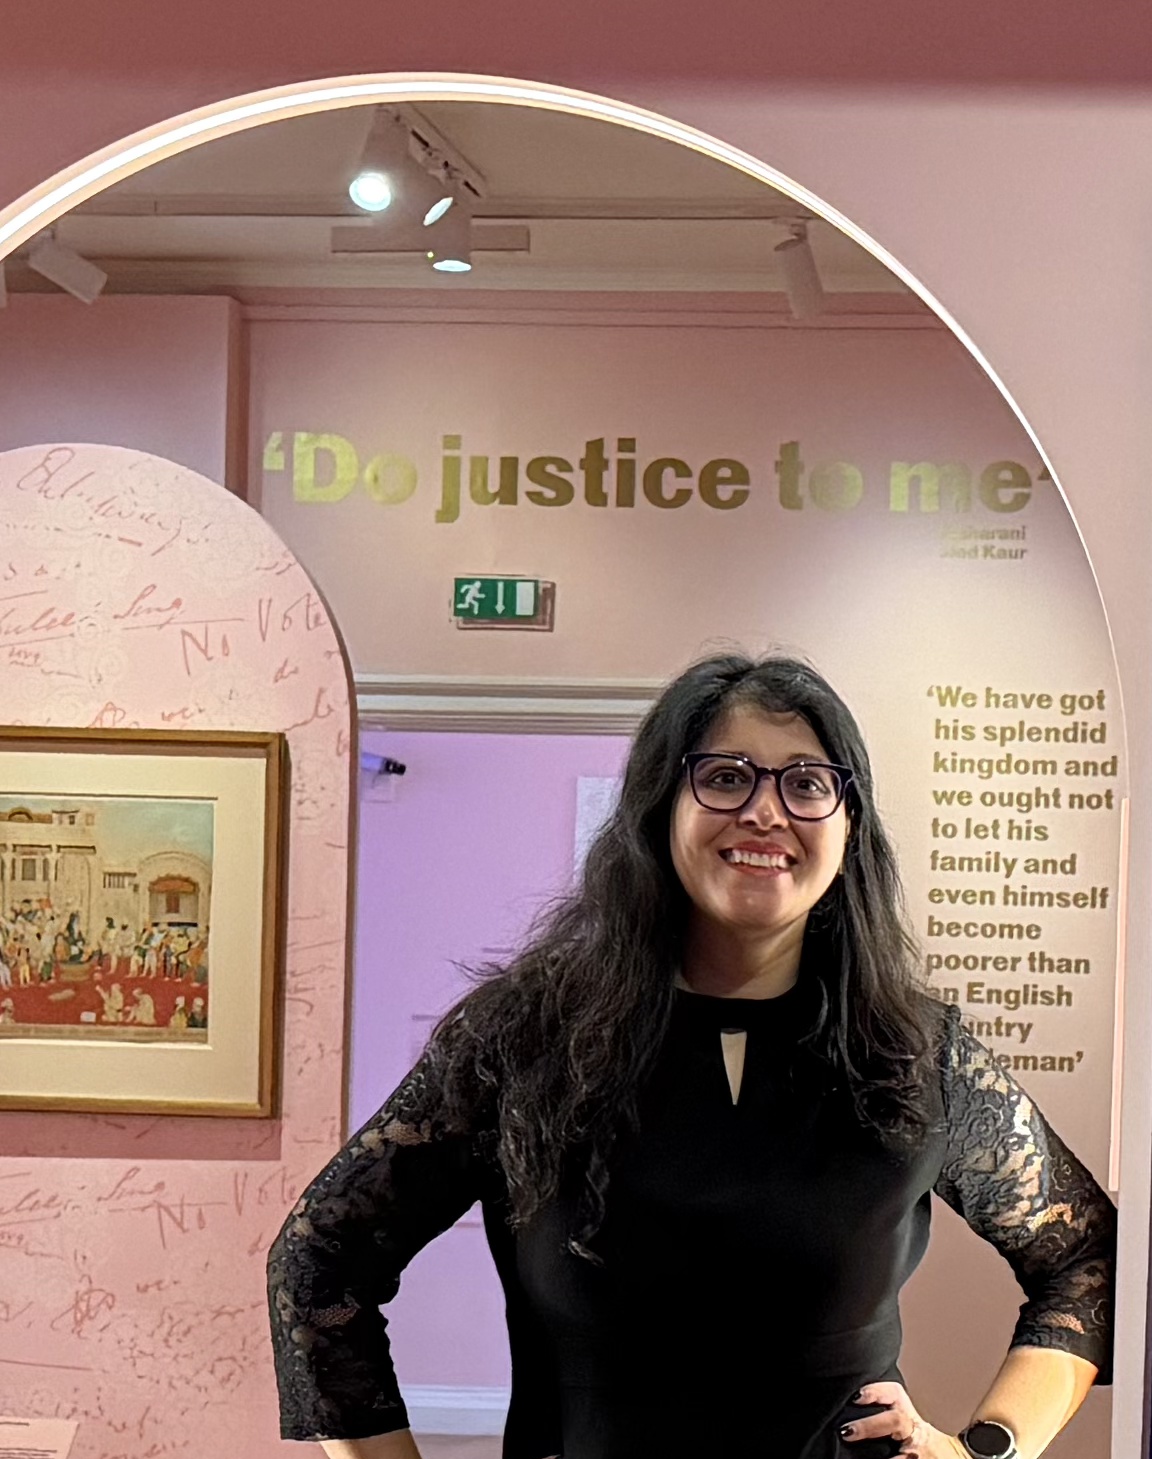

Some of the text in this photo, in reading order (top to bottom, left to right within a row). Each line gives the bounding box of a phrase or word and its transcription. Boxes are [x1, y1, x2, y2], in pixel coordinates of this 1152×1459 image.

[263, 431, 418, 506] ‘Do
[435, 434, 750, 523] justice
[774, 440, 864, 512] to
[927, 685, 1105, 716] ‘We have got
[935, 718, 1106, 747] his splendid
[933, 751, 1118, 780] kingdom and
[933, 786, 1113, 813] we ought not
[931, 817, 1049, 841] to let his
[930, 849, 1077, 878] family and
[928, 884, 1108, 909] even himself
[927, 915, 1041, 940] become
[925, 950, 1090, 977] poorer than
[967, 981, 1072, 1011] English
